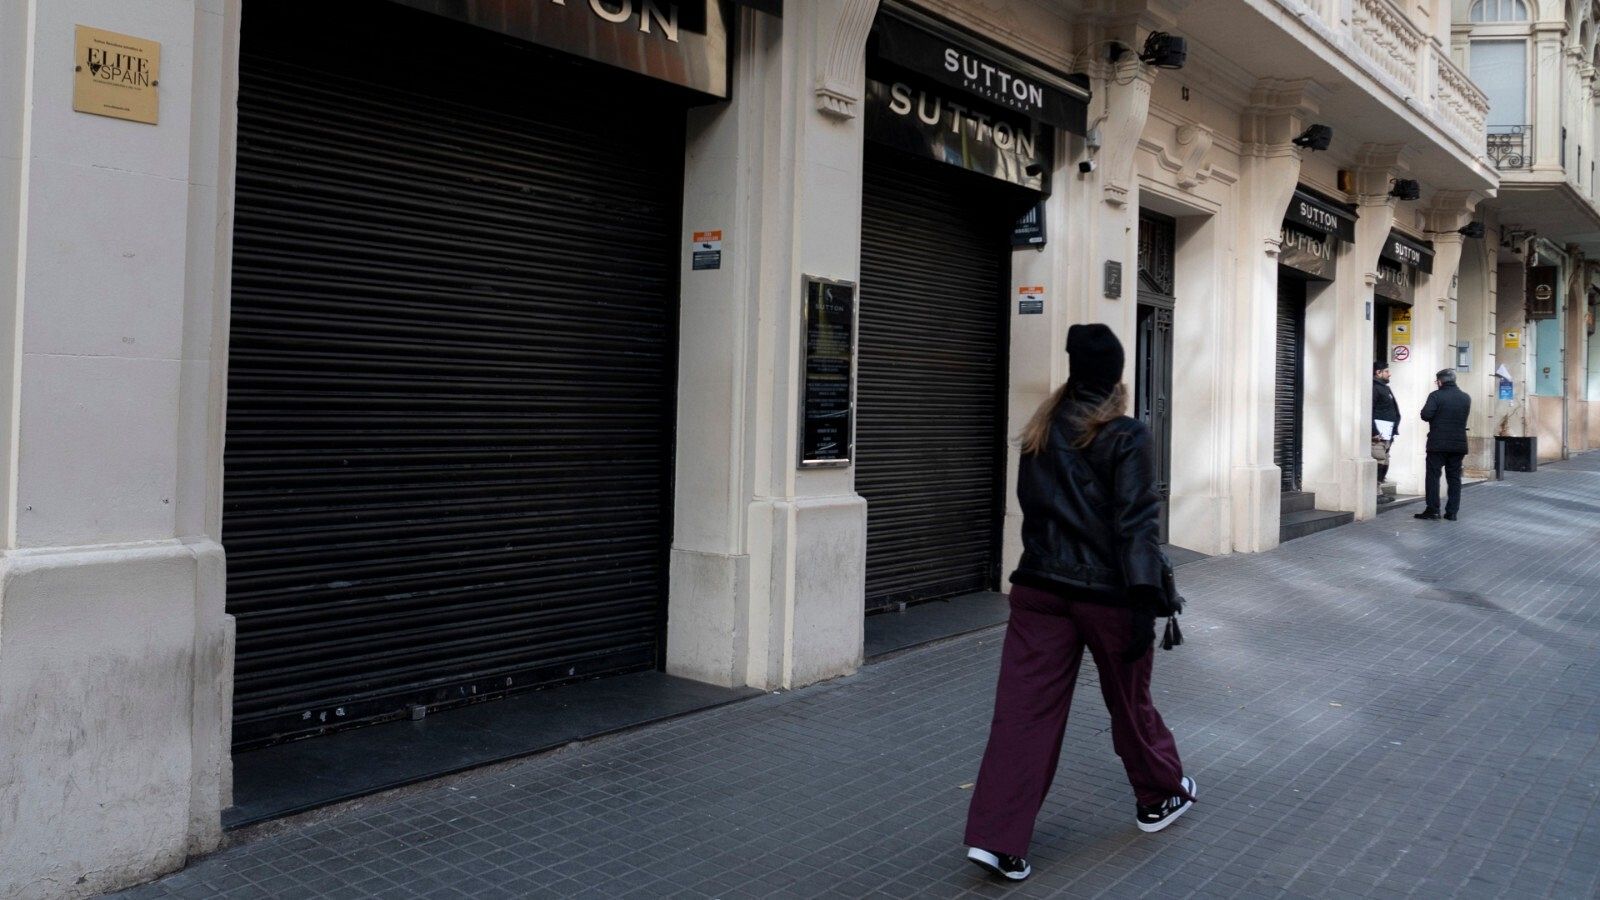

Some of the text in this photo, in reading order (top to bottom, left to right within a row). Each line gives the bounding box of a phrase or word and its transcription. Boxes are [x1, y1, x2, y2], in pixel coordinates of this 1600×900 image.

[552, 0, 680, 43] ON
[87, 47, 149, 74] ELITE
[100, 65, 149, 87] SPAIN
[944, 48, 1043, 108] SUTTON
[889, 82, 1038, 159] SUTTON
[1300, 202, 1338, 229] SUTTON
[1395, 242, 1420, 263] SUTTON
[1377, 265, 1409, 287] UTTON
